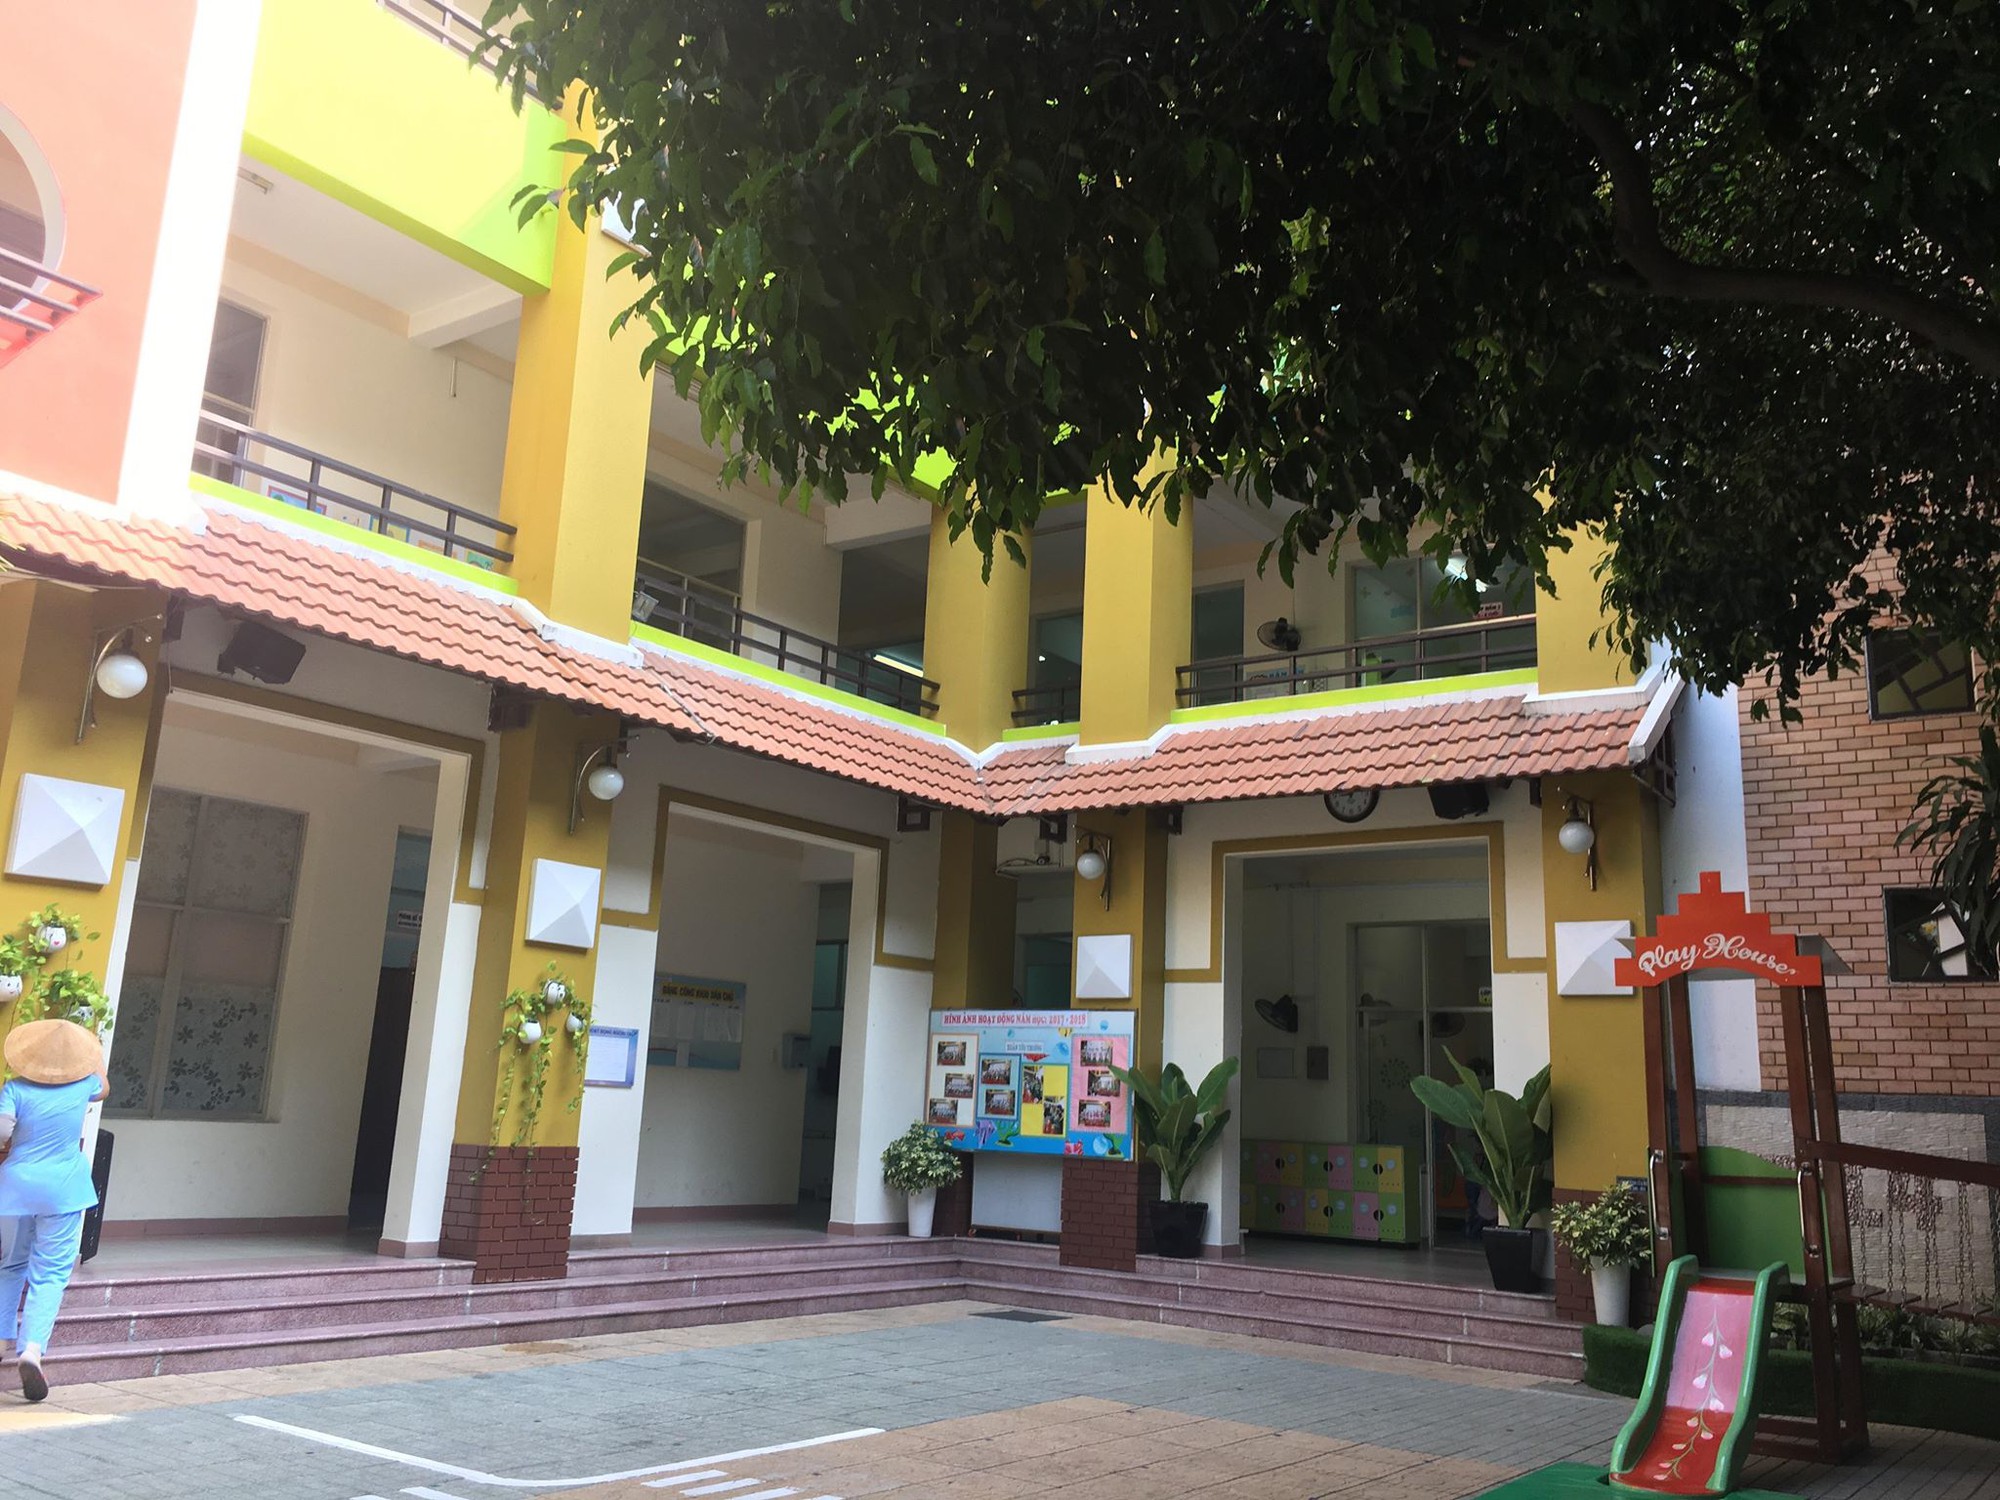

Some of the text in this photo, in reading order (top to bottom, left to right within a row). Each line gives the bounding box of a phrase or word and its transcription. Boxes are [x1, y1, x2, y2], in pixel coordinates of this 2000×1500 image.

[1638, 933, 1796, 977] Play House
[944, 1012, 961, 1024] HÌNH
[962, 1011, 977, 1024] ẢNH
[978, 1014, 996, 1026] HOẠT
[996, 1012, 1015, 1025] ĐỘNG
[1016, 1012, 1031, 1024] NĂM
